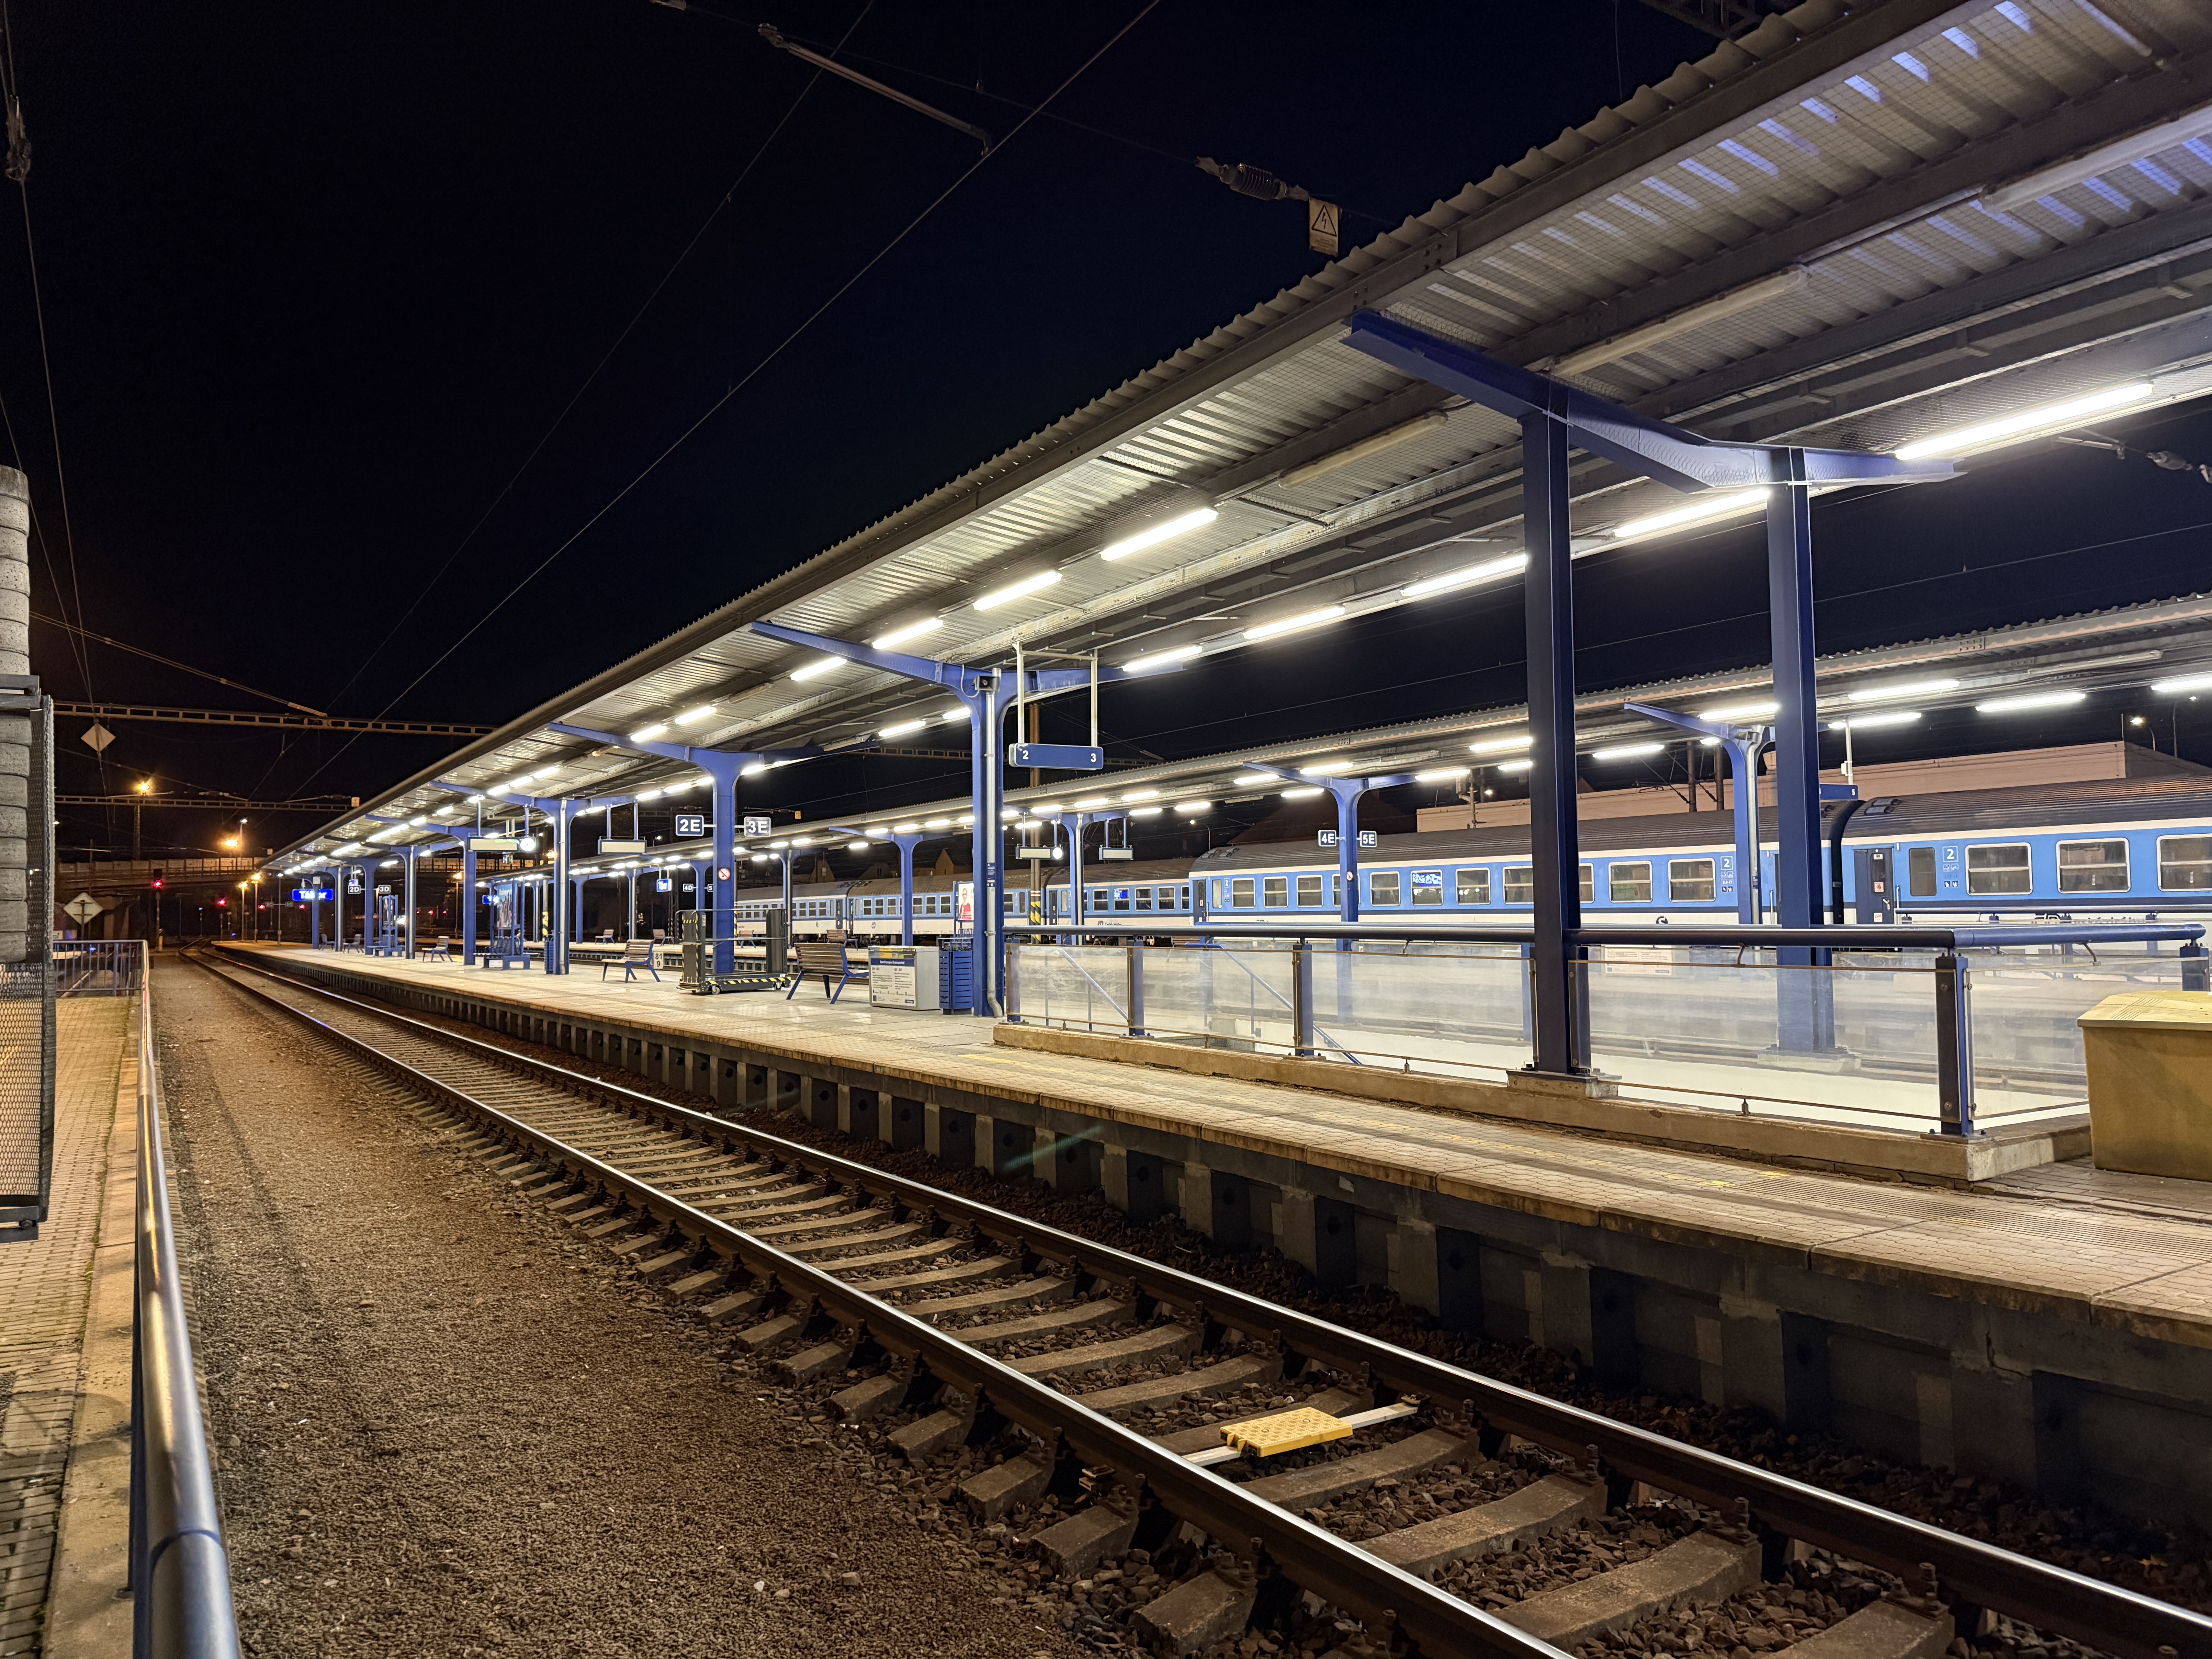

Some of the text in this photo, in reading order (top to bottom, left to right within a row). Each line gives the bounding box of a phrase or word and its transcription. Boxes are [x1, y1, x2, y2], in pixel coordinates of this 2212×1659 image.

[1022, 750, 1096, 763] 2 3
[680, 819, 701, 832] 2E
[748, 821, 768, 833] 3E
[1321, 833, 1335, 843] 4E
[1362, 834, 1375, 844] 5E
[1947, 849, 1954, 859] 2
[1724, 859, 1730, 867] 2
